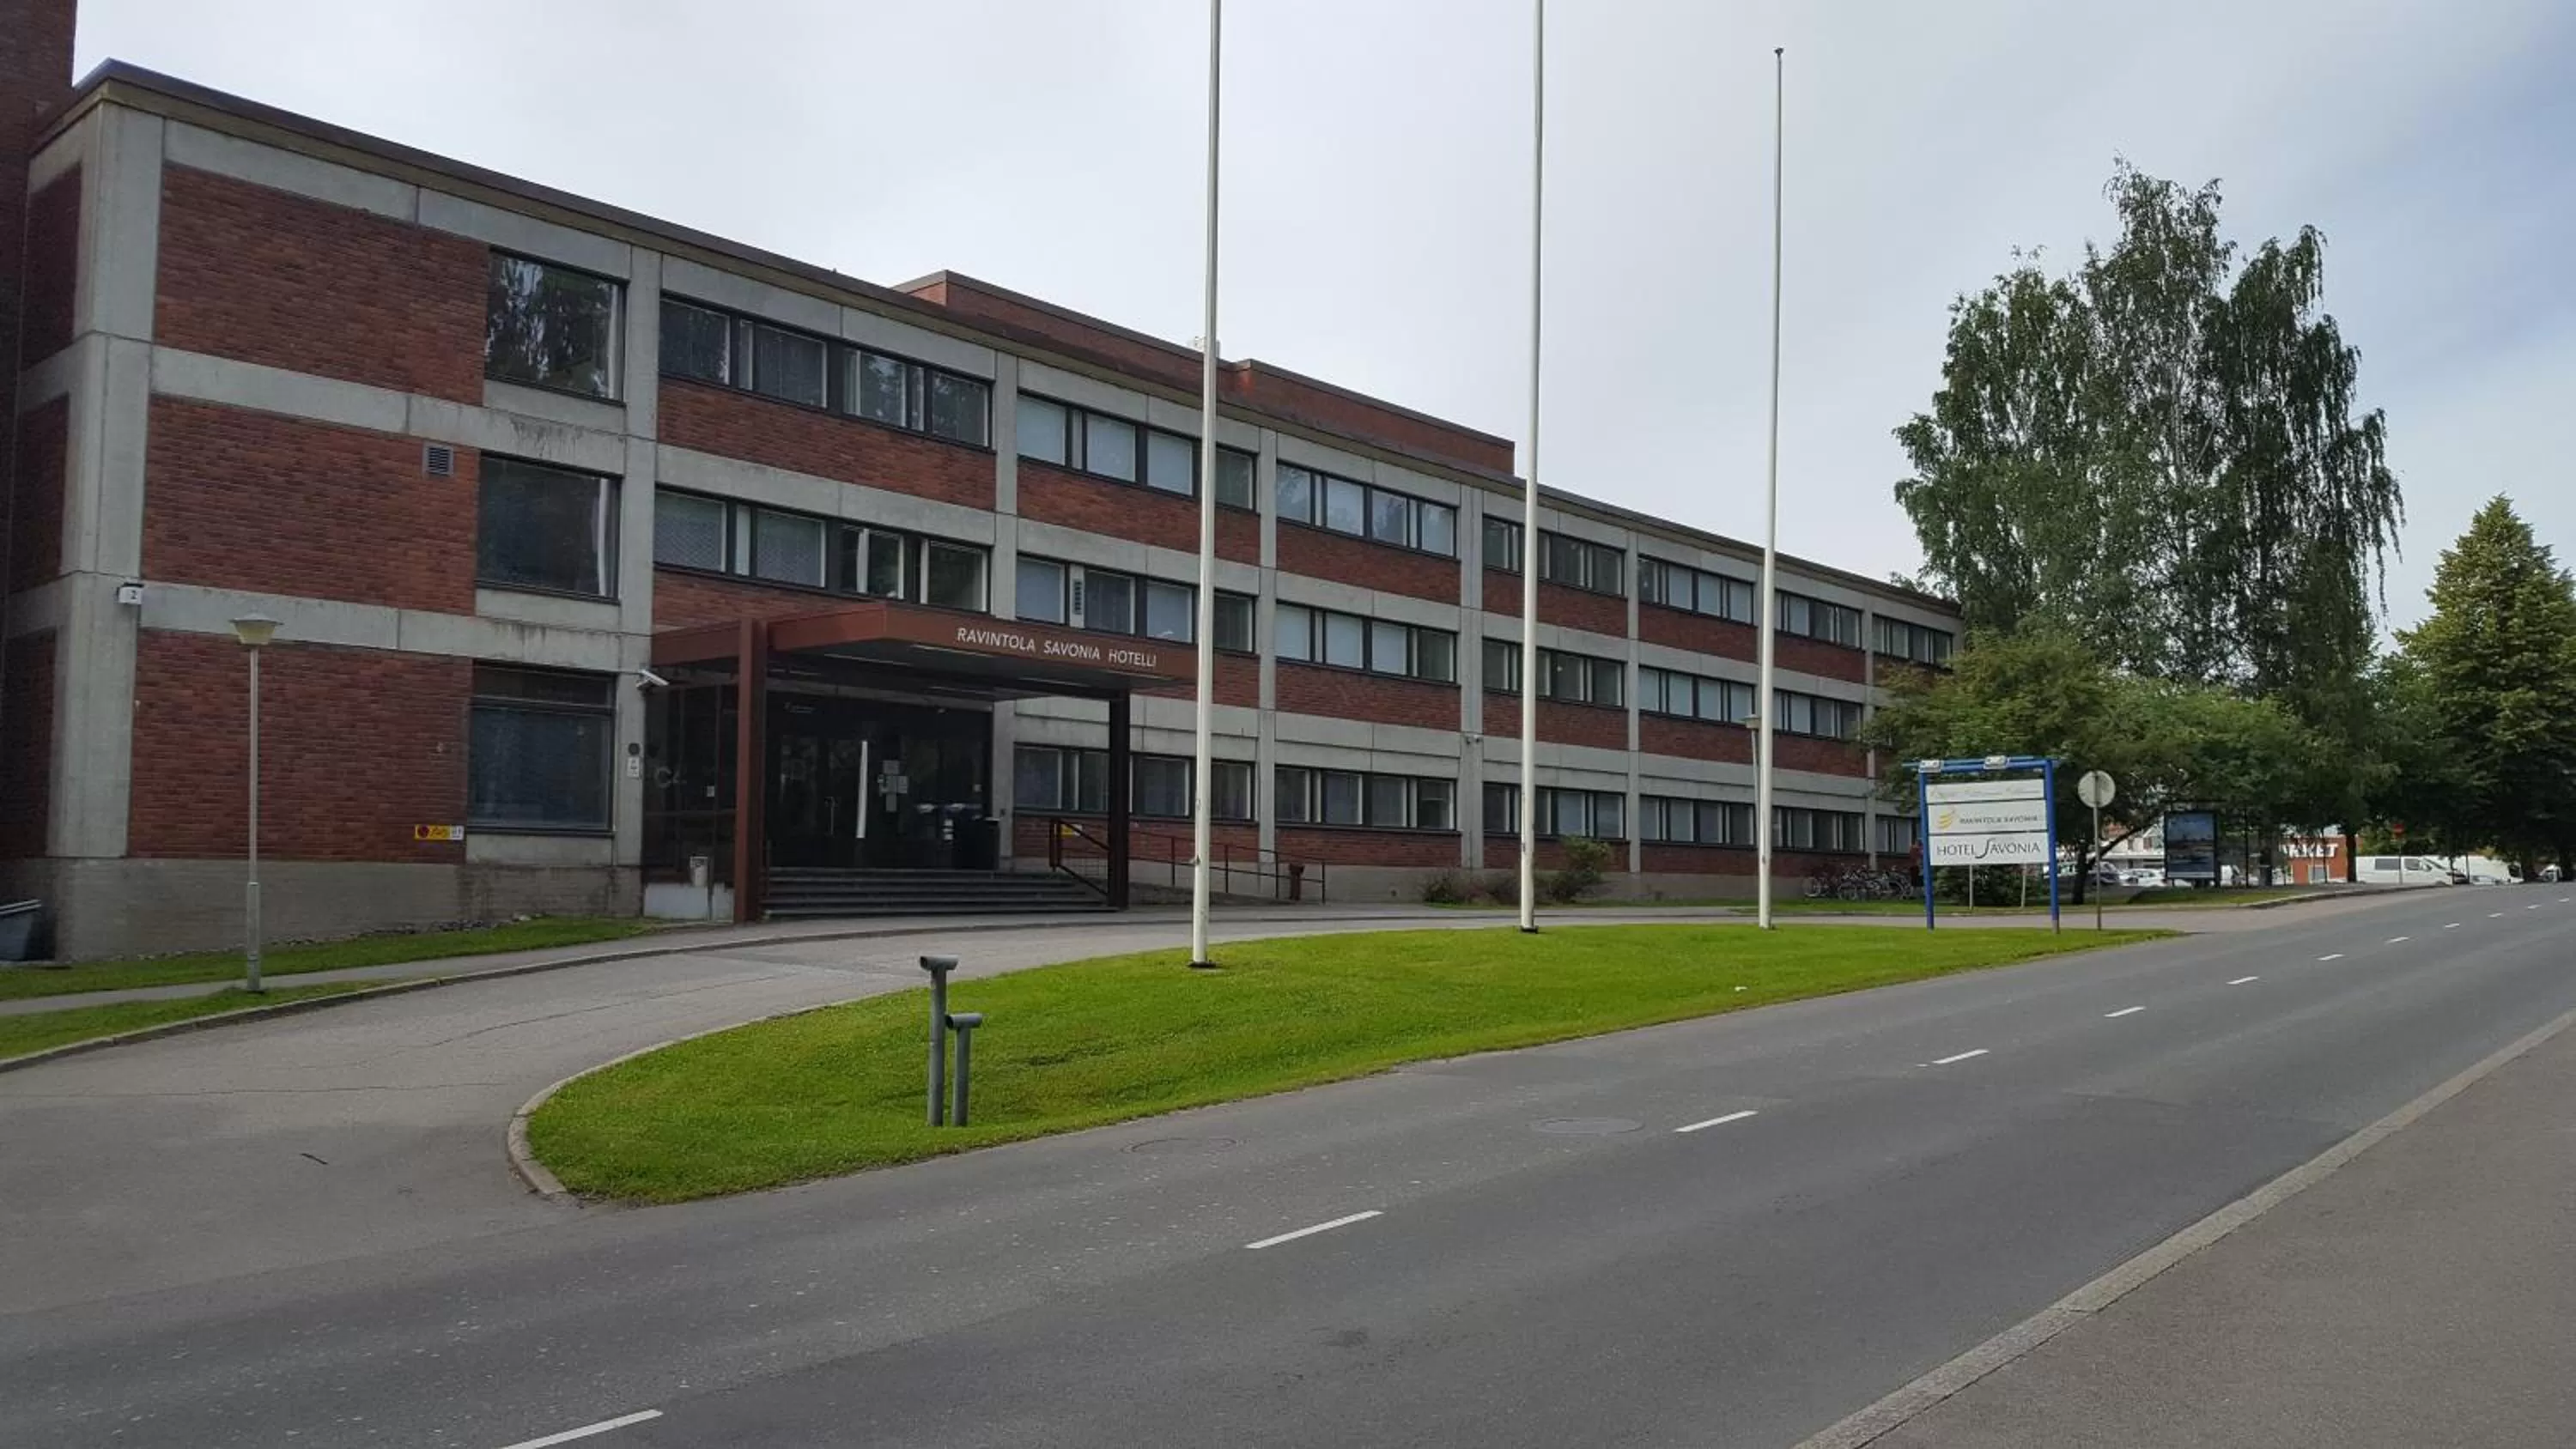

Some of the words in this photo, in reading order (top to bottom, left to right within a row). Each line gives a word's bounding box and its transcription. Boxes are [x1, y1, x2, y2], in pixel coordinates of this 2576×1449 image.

[957, 627, 1036, 653] RAVINTOLA
[1043, 640, 1101, 660] SAVONIA
[1108, 648, 1157, 667] HOTELLI
[1936, 844, 1975, 857] HOTEL
[1975, 838, 2041, 859] SAVONIA
